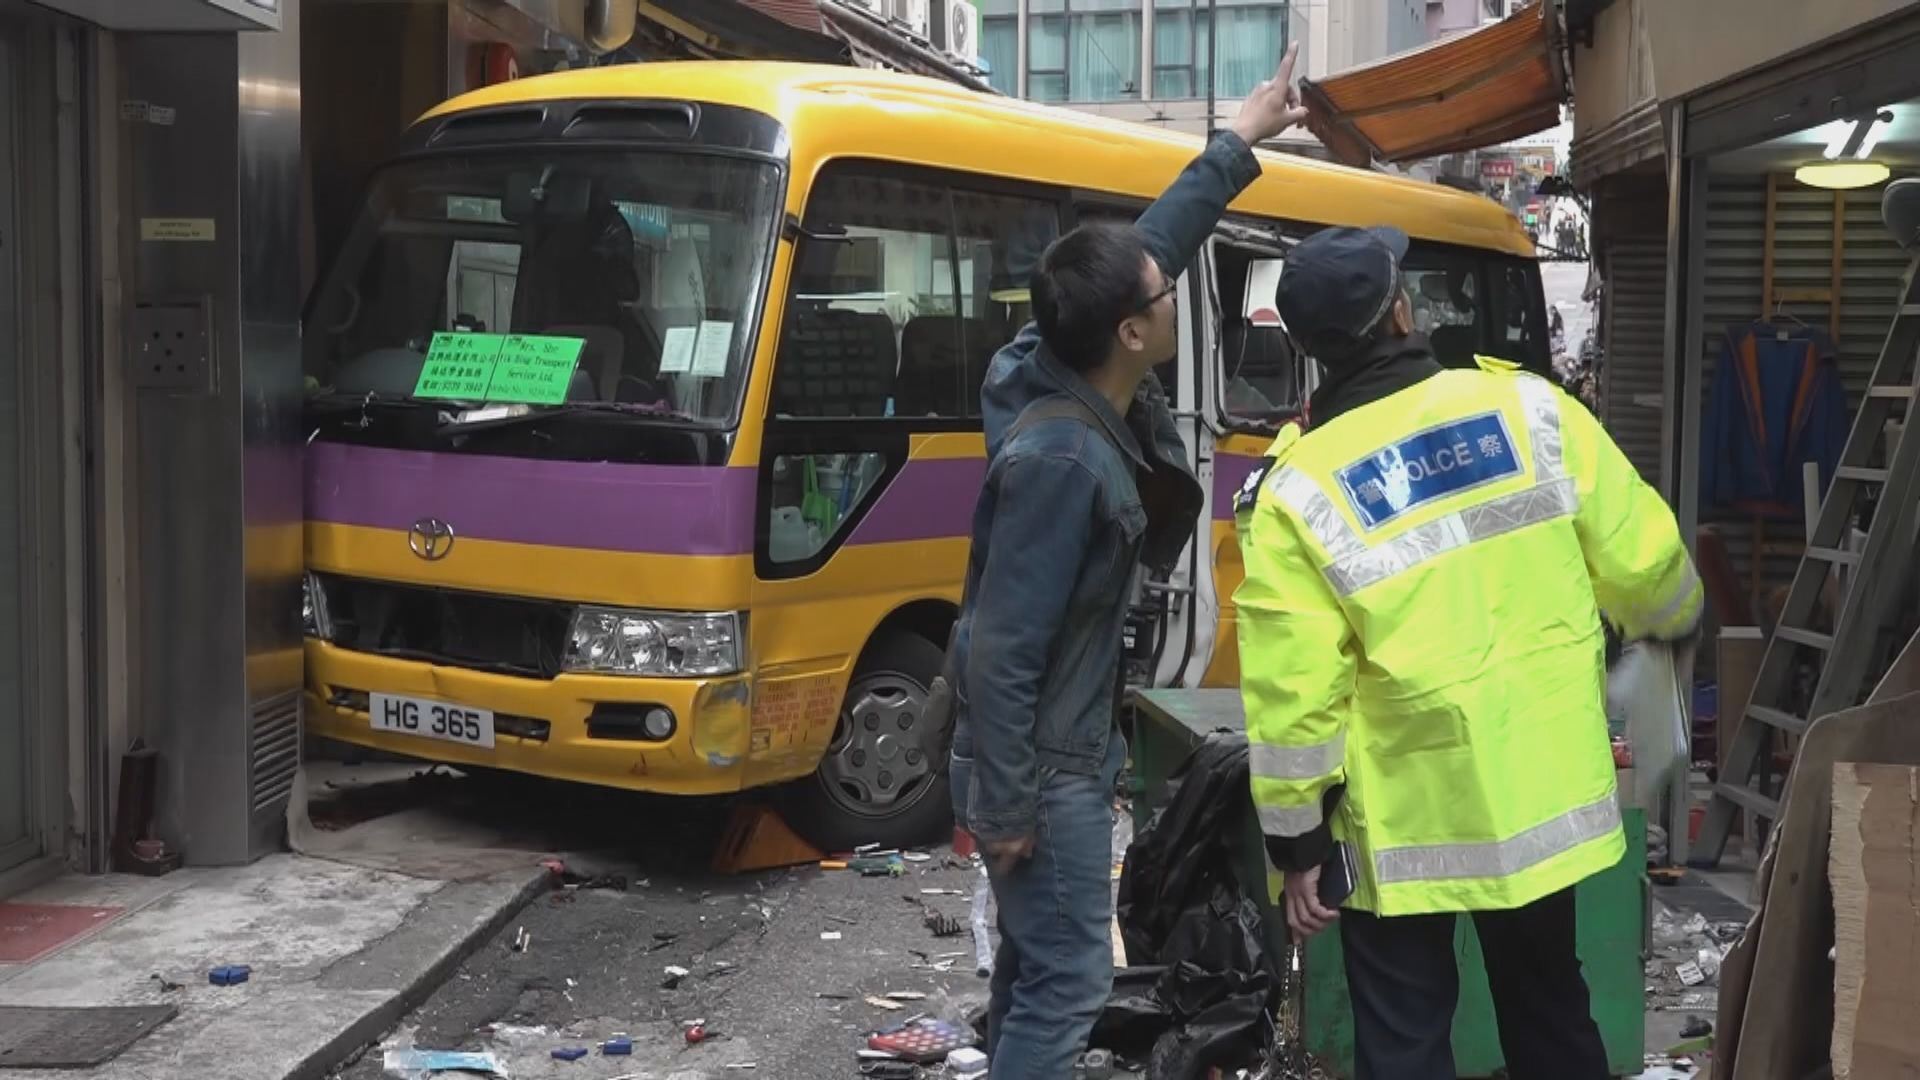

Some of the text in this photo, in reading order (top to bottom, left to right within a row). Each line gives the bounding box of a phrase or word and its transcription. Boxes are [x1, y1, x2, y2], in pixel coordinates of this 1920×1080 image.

[534, 355, 572, 369] Transport
[506, 370, 538, 382] Service
[1477, 434, 1503, 458] 察
[383, 698, 480, 741] HG 365
